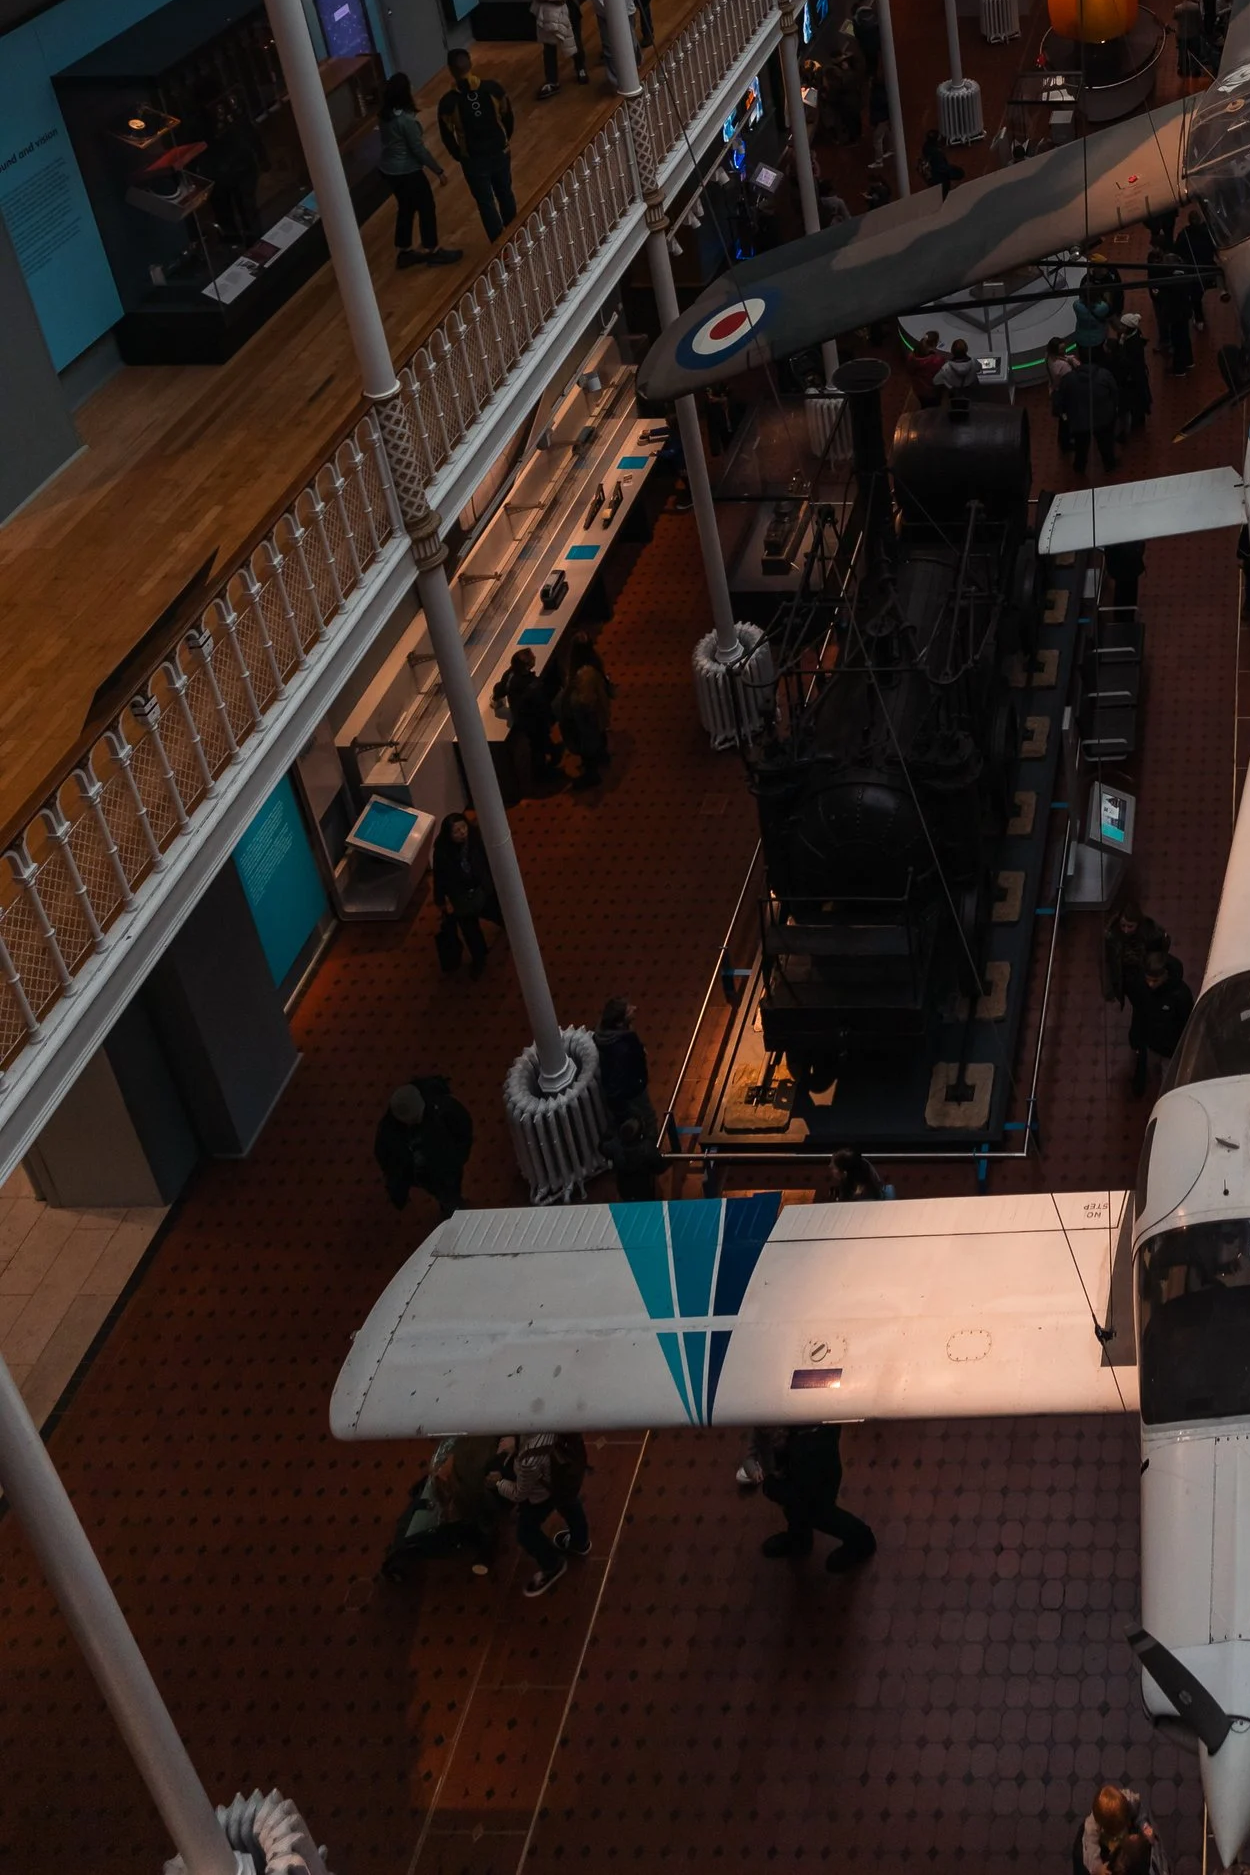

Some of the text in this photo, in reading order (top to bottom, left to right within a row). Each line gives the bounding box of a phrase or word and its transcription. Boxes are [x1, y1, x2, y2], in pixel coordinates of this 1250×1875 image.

[18, 141, 34, 159] and
[35, 127, 59, 146] vision
[1083, 1202, 1109, 1211] STEP
[1086, 1211, 1102, 1219] NO
